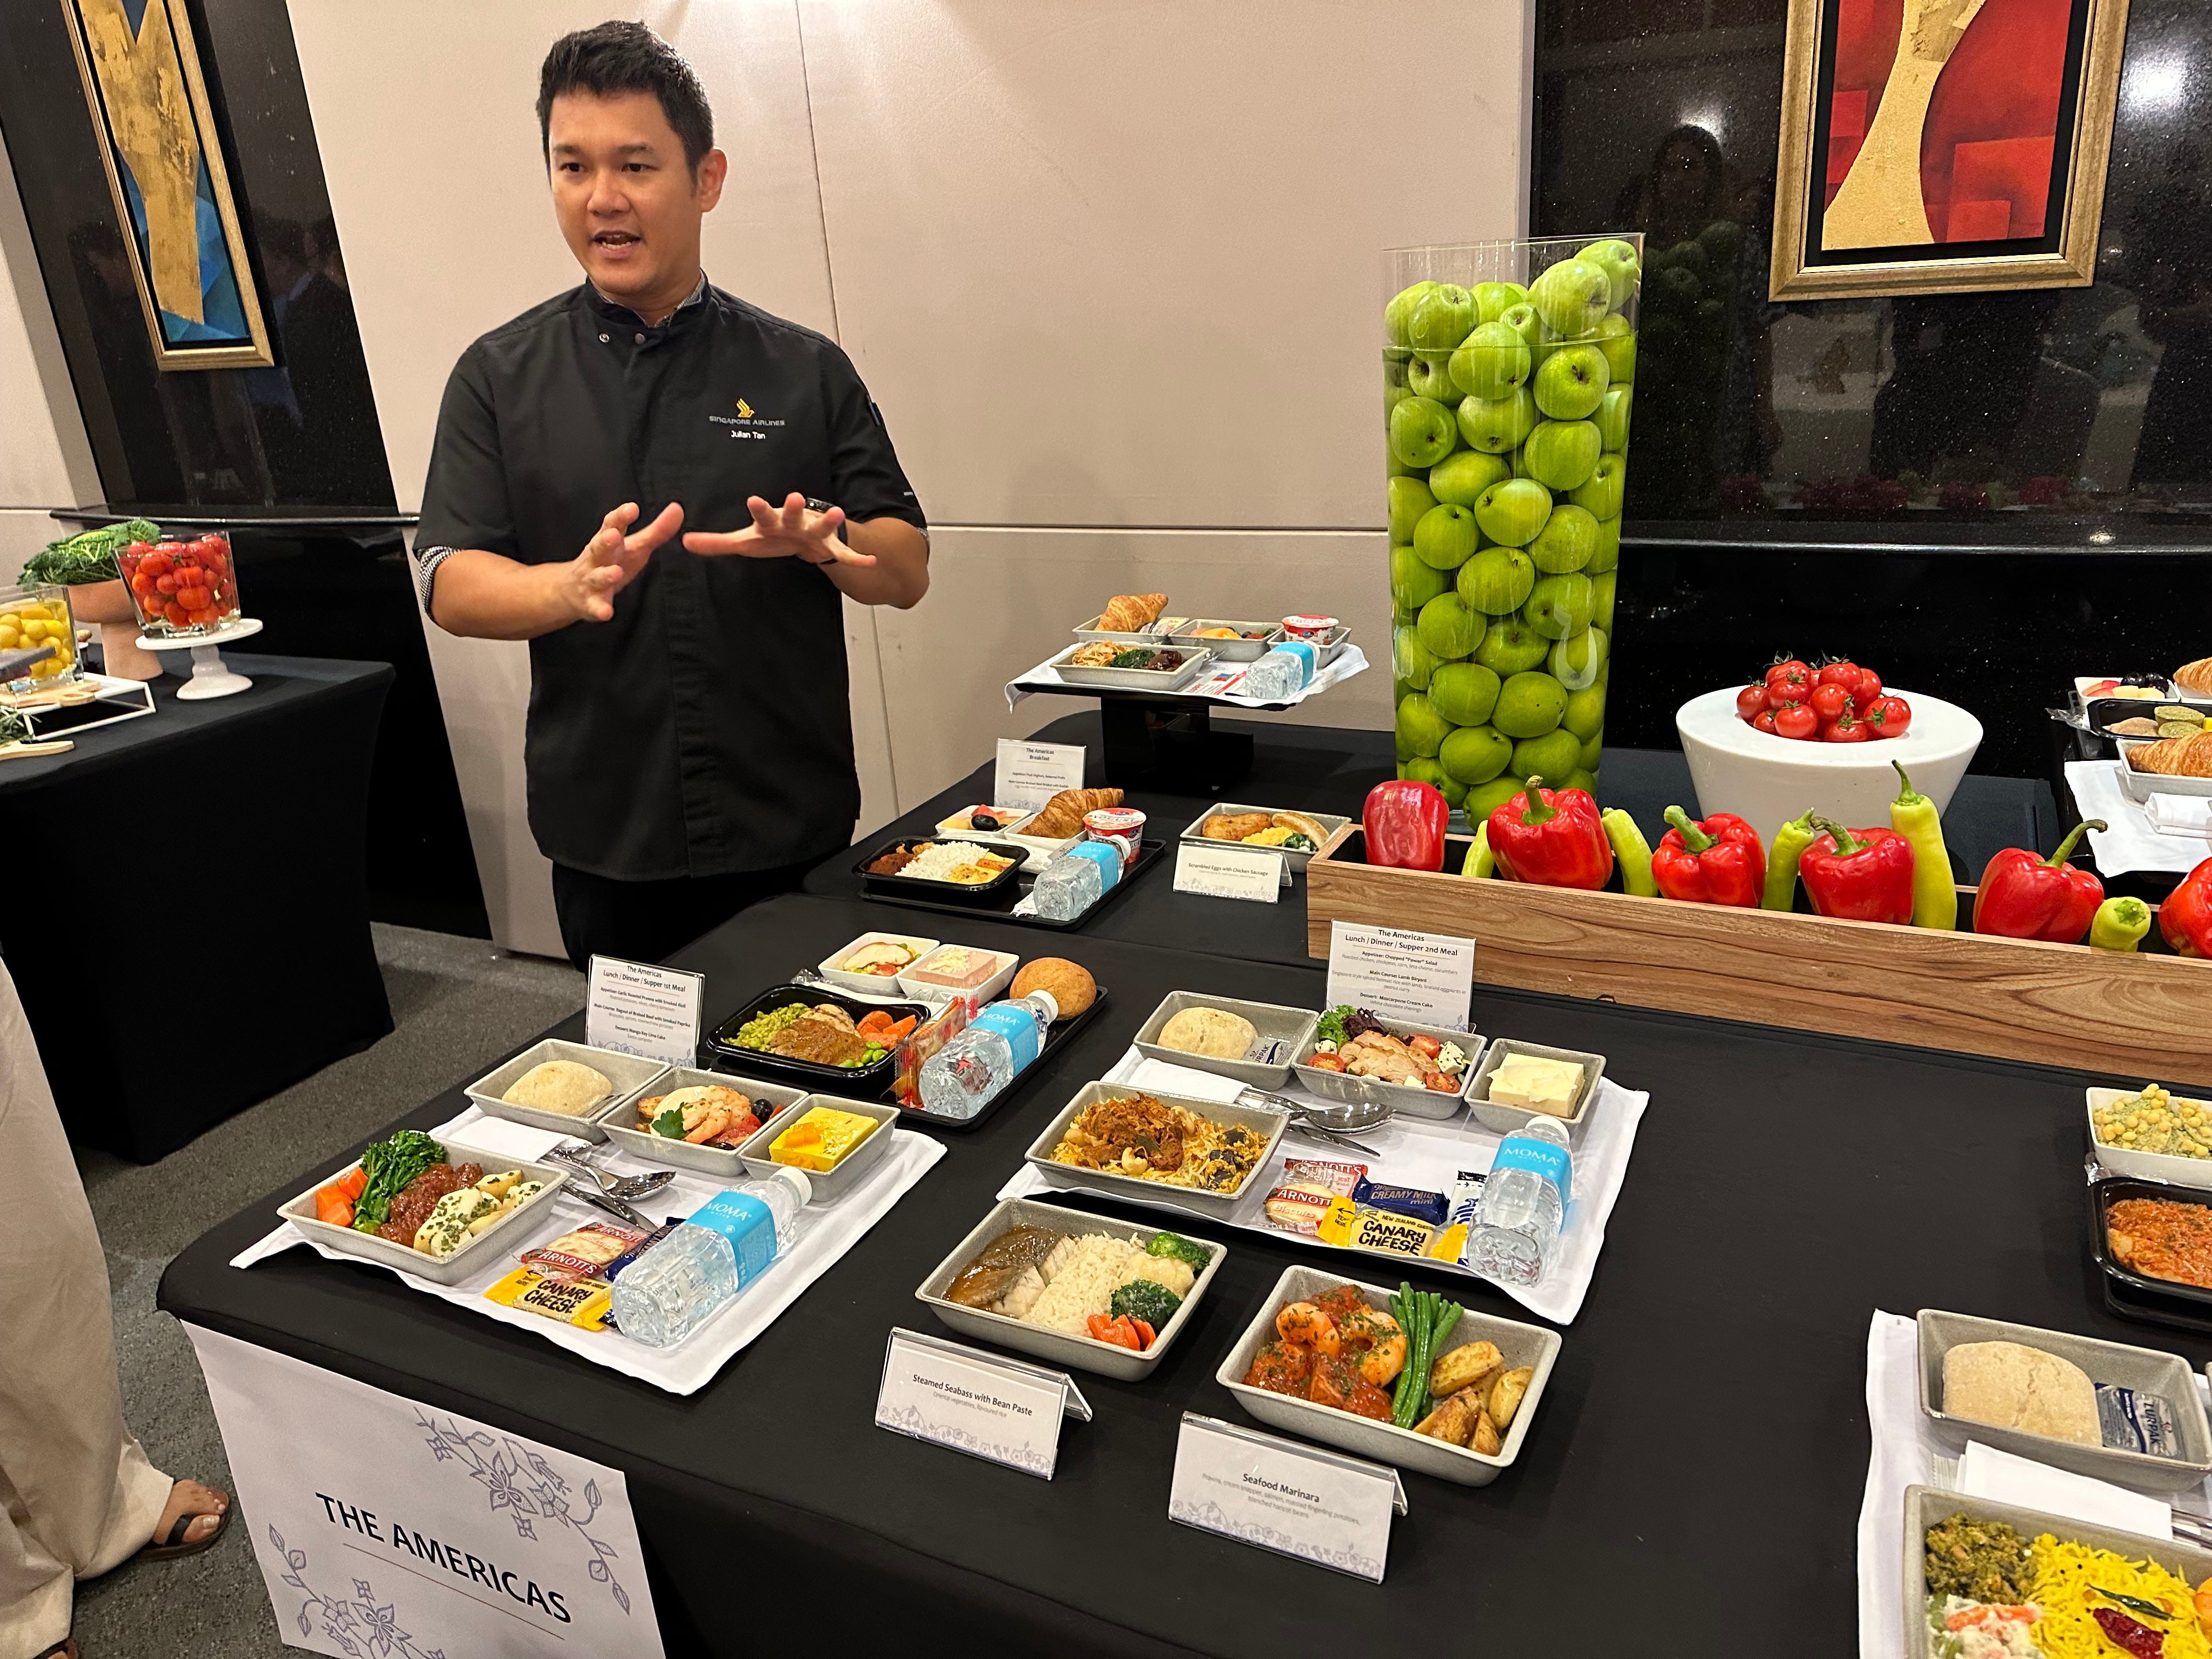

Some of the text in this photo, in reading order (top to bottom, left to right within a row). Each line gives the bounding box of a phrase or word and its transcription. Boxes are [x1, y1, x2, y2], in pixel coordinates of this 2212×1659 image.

[709, 415, 751, 425] SINGAPORE
[731, 430, 751, 438] Julian
[1345, 934, 1365, 943] Lunch
[1370, 938, 1393, 947] Dinner
[1398, 942, 1424, 952] Supper
[1440, 947, 1458, 956] Meal
[1392, 931, 1425, 941] Americas
[603, 969, 618, 978] Lunch
[622, 974, 640, 983] Dinner
[644, 978, 663, 988] Supper
[672, 984, 686, 992] Meal
[637, 967, 662, 978] Americas
[1379, 995, 1406, 1004] Mascarpone
[983, 1014, 1017, 1025] MOMA
[1255, 1045, 1271, 1063] URPAK
[1504, 1148, 1557, 1166] MOMA
[1303, 1159, 1362, 1178] NOTT'S
[1277, 1189, 1331, 1206] ARNOTT
[1371, 1190, 1437, 1200] CREAMY MILK
[1363, 1221, 1427, 1244] CANARY
[1395, 1217, 1416, 1226] ZEALAND
[595, 1226, 643, 1243] ARNOTT
[1358, 1232, 1423, 1256] CHEESE
[538, 1251, 597, 1274] ARNOTT'S
[537, 1279, 594, 1301] CANARY
[524, 1290, 582, 1314] CHEESE
[912, 1374, 1032, 1416] Steamed Seabass with Bean Paste
[933, 1391, 951, 1401] Oriental
[951, 1397, 976, 1409] vegetables,
[976, 1404, 998, 1415] flavoured
[2143, 1402, 2160, 1444] LURPAK
[1223, 1480, 1240, 1489] cream
[1263, 1492, 1285, 1503] salmon,
[1285, 1498, 1307, 1509] roasted
[1307, 1504, 1333, 1518] fingerling
[1242, 1473, 1320, 1503] Seafood Marinara
[1247, 1496, 1310, 1519] blanched haricot beans
[315, 1492, 572, 1623] THE AMERICAS
